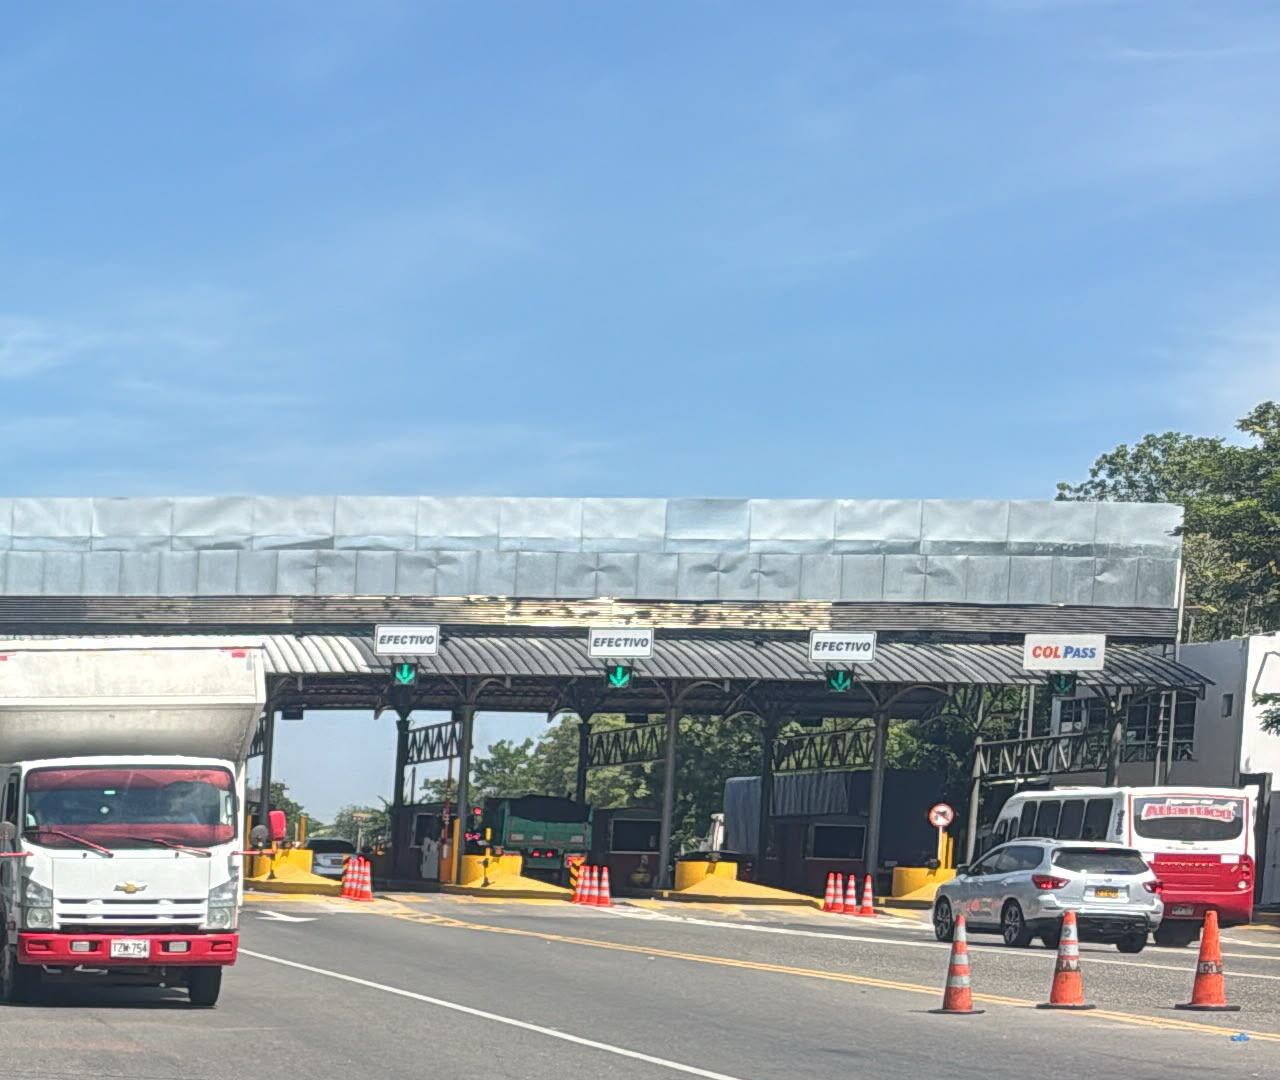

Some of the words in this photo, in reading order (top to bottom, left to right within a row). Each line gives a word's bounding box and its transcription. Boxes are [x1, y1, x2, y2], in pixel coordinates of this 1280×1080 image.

[379, 634, 435, 645] EFECTIVO
[592, 637, 649, 648] EFECTIVO
[814, 641, 871, 652] EFECTIVO
[1032, 645, 1061, 659] COL
